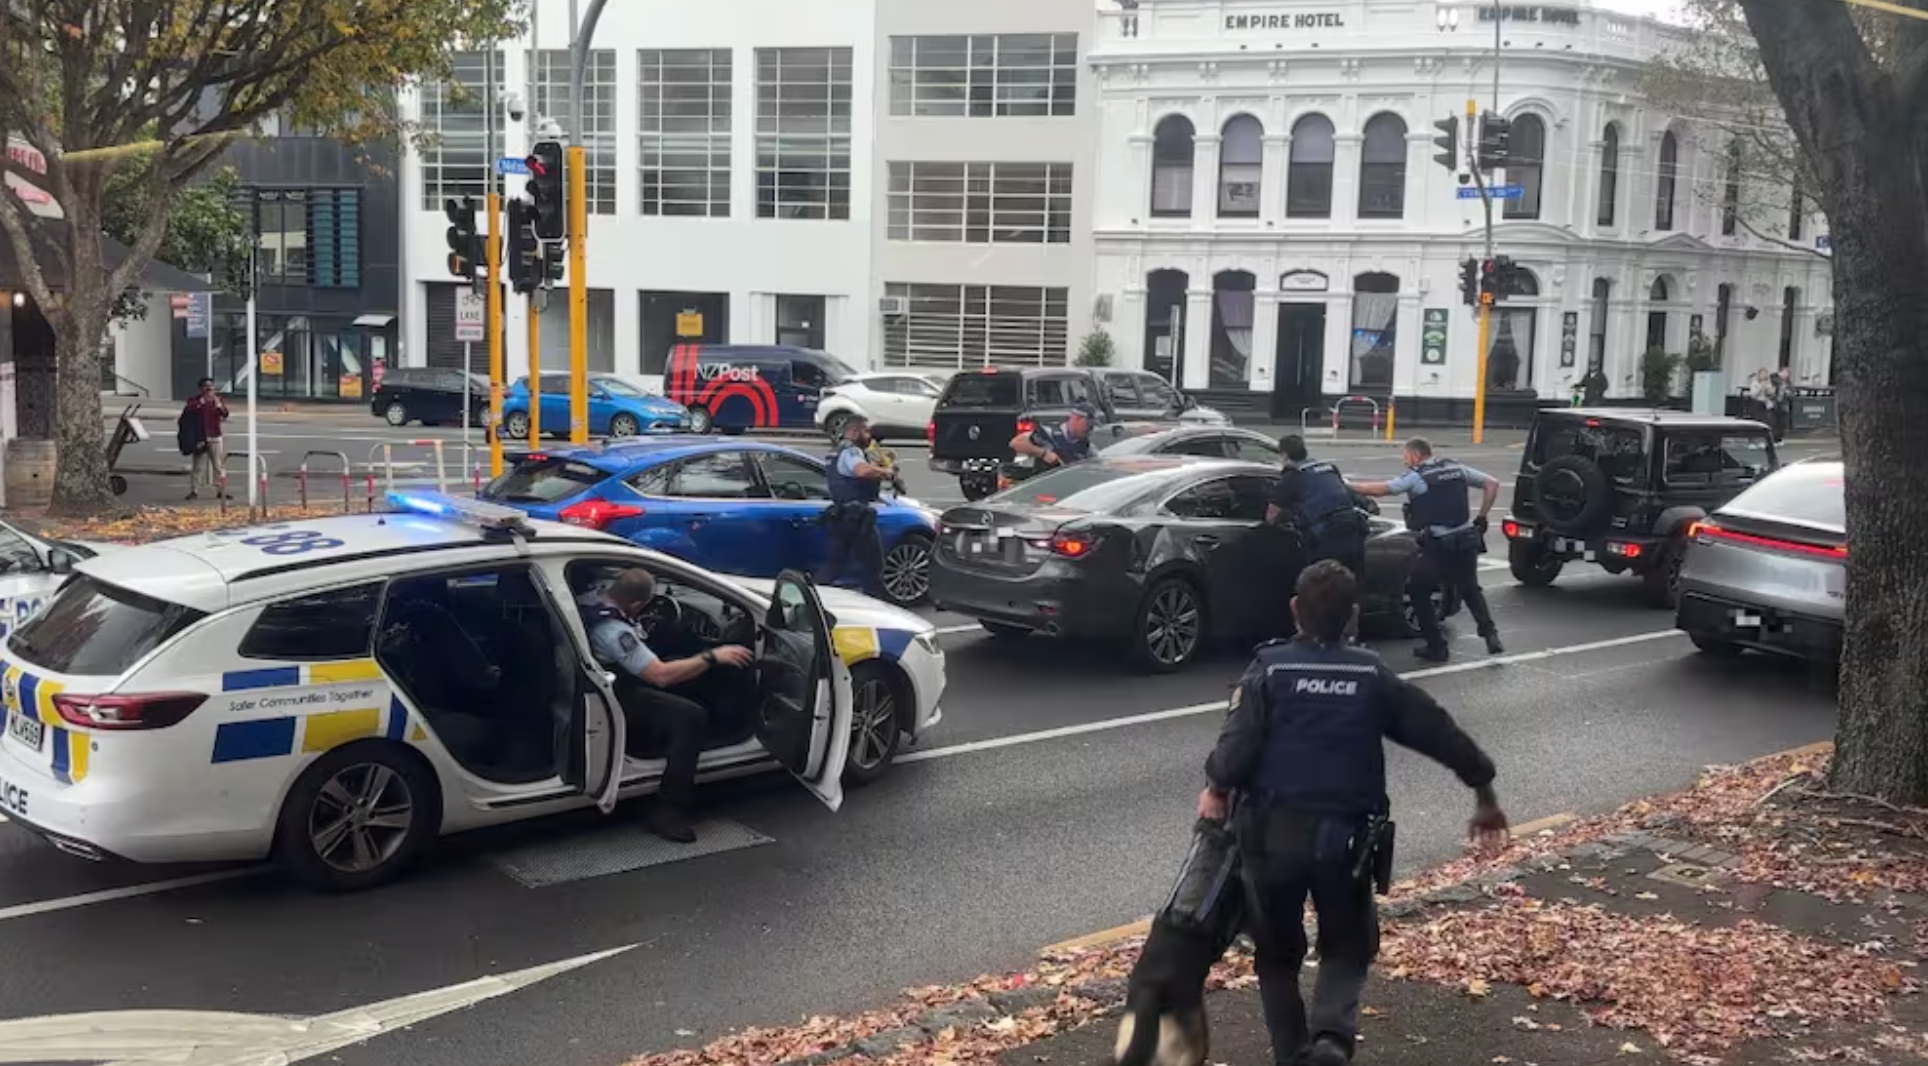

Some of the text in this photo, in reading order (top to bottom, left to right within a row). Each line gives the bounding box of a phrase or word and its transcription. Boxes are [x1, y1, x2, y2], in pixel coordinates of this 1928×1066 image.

[1225, 13, 1344, 29] EMPIRE HOTEL
[460, 311, 480, 321] LANE
[694, 363, 759, 381] NZPost
[1295, 678, 1357, 695] POLICE
[228, 688, 373, 712] Safer Communities Together
